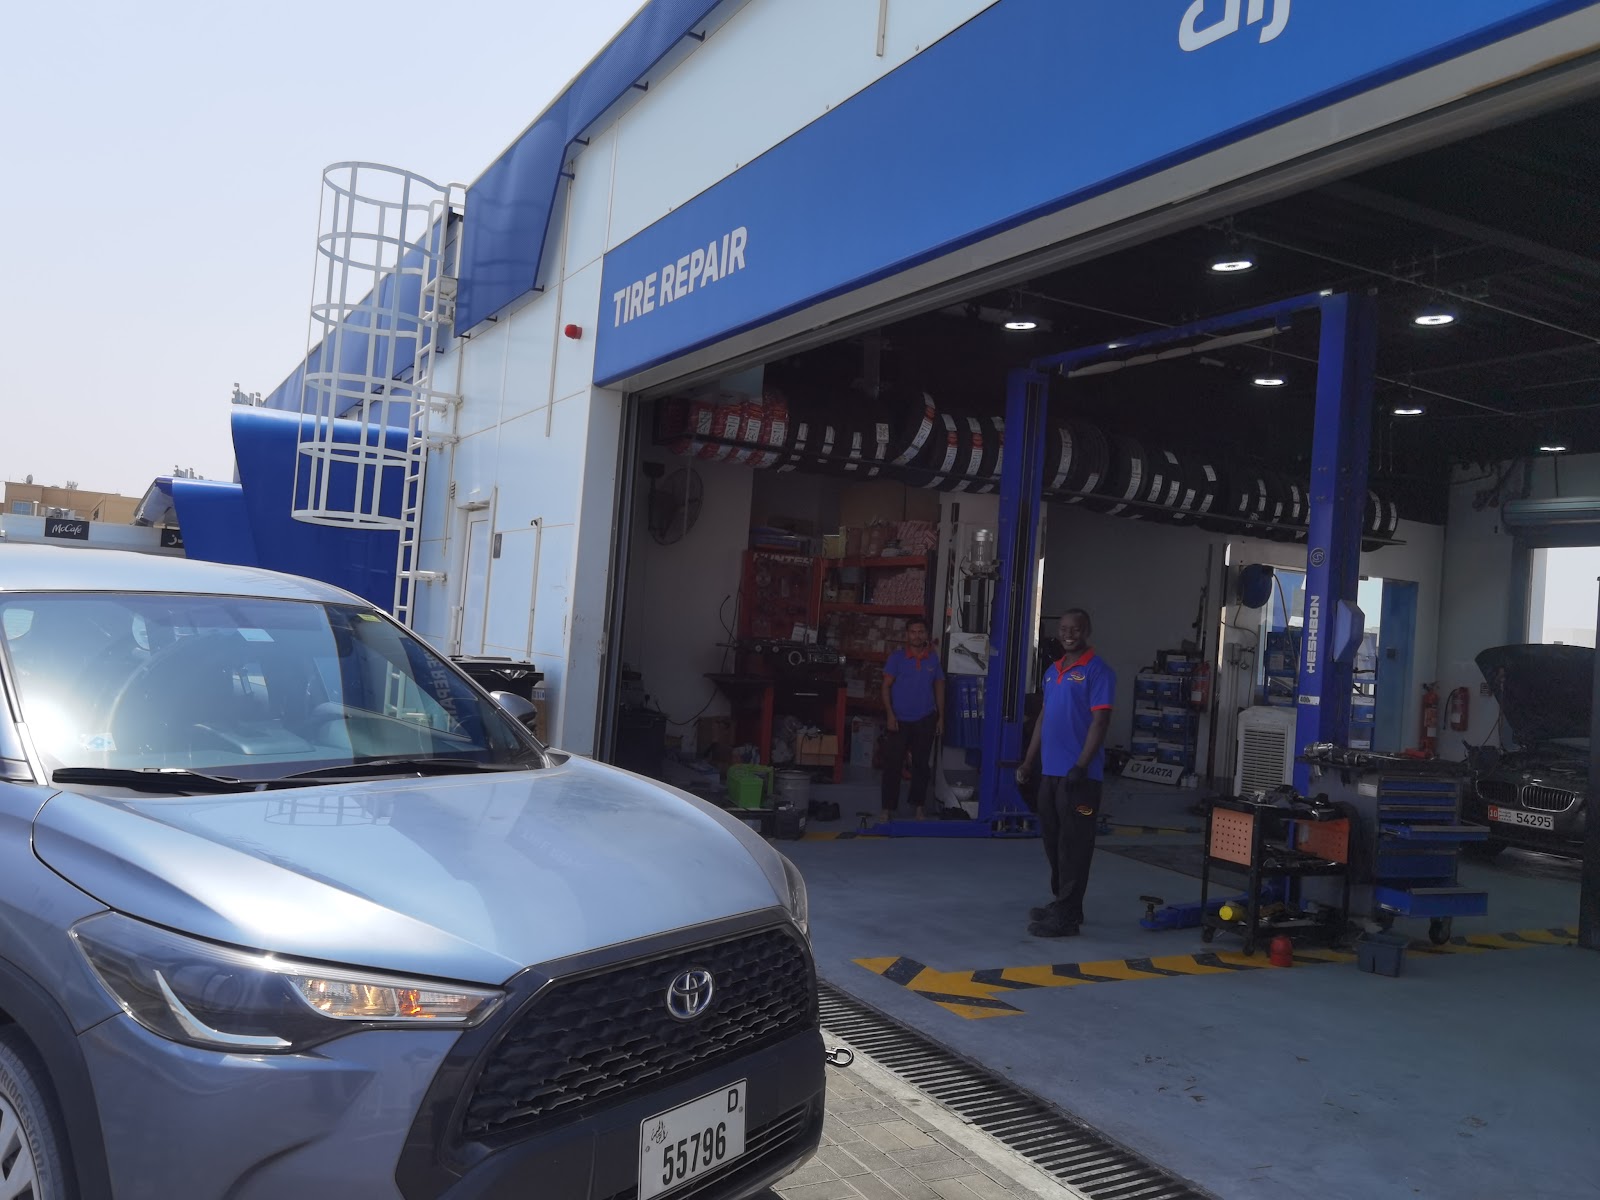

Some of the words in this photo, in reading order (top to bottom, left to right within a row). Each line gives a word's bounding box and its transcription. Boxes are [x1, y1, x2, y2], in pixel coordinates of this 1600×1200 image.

[613, 271, 658, 328] TIRE
[659, 226, 748, 307] REPAIR
[1306, 595, 1320, 674] HESHBON
[1142, 765, 1173, 778] VARTA
[1489, 809, 1498, 818] 10
[1516, 812, 1551, 828] 54295
[0, 1064, 48, 1181] RIDGESTONE
[727, 1088, 739, 1114] D
[662, 1121, 727, 1186] 55796
